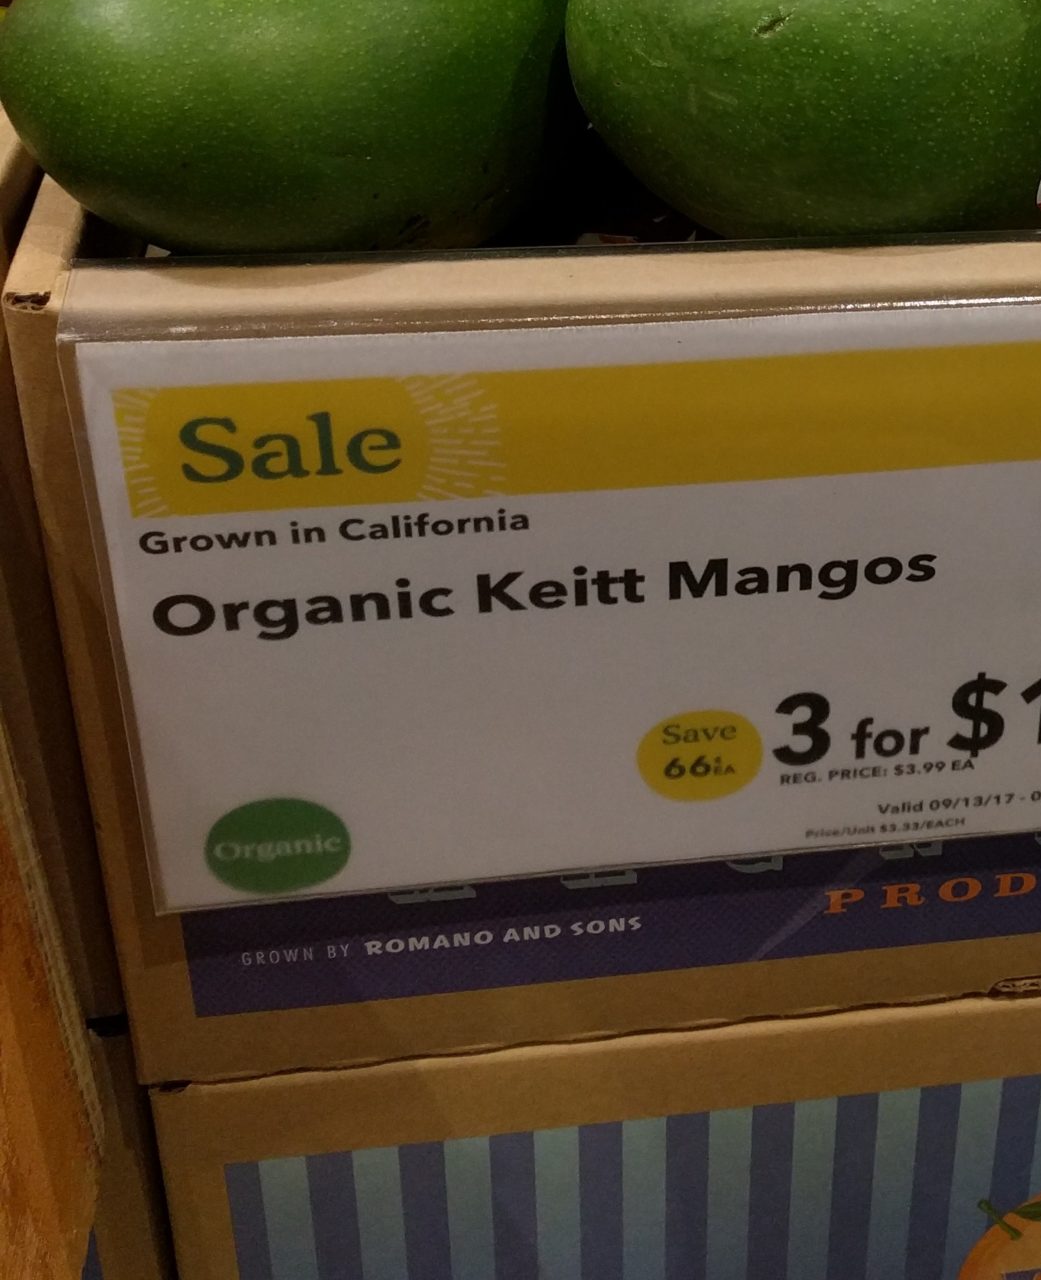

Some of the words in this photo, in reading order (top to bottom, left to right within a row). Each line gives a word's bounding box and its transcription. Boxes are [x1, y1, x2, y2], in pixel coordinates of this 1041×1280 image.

[178, 411, 403, 484] Sale
[138, 530, 278, 556] Grown
[290, 521, 326, 545] in
[338, 508, 531, 541] California
[152, 577, 455, 641] Organic
[475, 565, 646, 613] Keitt
[668, 553, 938, 601] Mangos
[662, 723, 737, 746] Save
[772, 692, 831, 767] 3
[850, 717, 930, 760] for
[779, 772, 823, 786] REG.
[827, 766, 889, 782] PRICE:
[893, 761, 946, 777] $3.99
[951, 757, 976, 772] EA
[877, 801, 924, 815] Valid
[928, 793, 1018, 812] 09/13/17
[212, 832, 344, 865] Organic
[240, 946, 314, 968] GROWN
[327, 942, 350, 960] BY
[364, 928, 494, 958] ROMANO
[503, 923, 562, 944] AND
[572, 915, 643, 937] SONS
